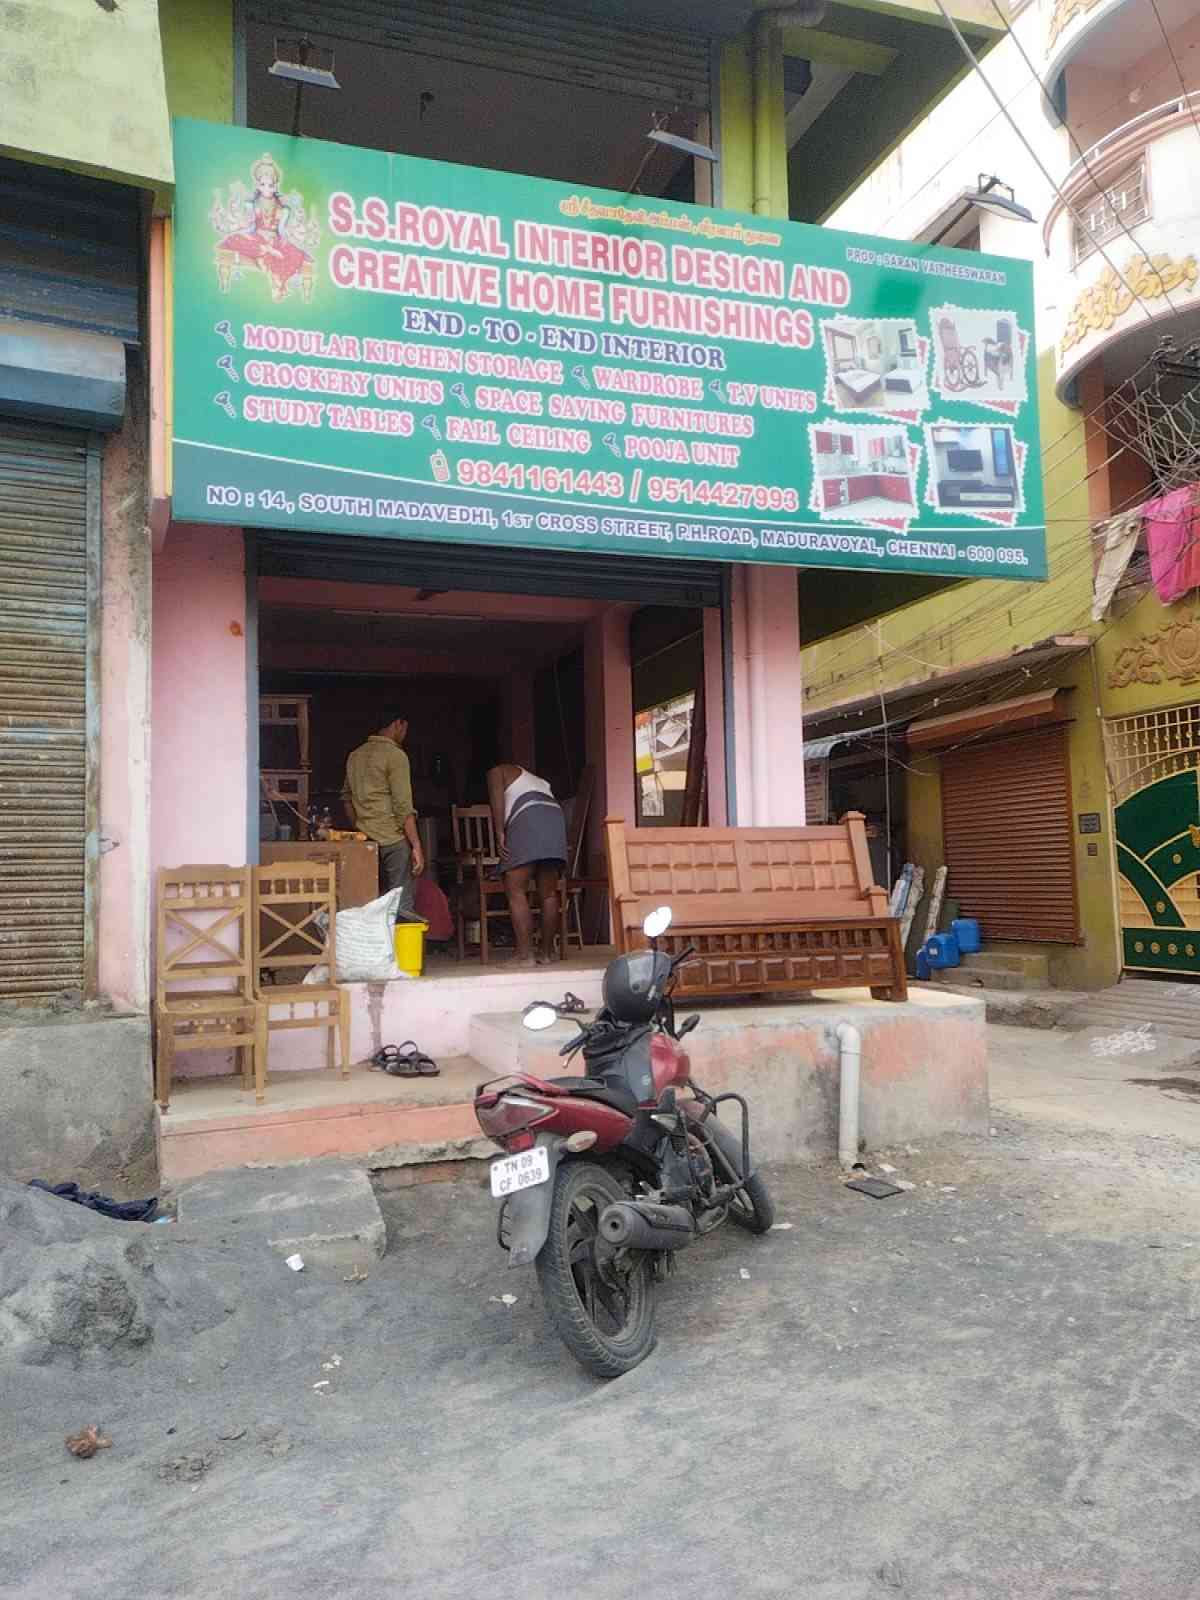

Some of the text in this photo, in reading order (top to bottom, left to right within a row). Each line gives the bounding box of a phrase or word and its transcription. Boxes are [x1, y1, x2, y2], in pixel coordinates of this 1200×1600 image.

[331, 193, 849, 306] S.S.ROYAL INTERIOR DESIGN AND
[847, 248, 875, 265] PROP
[331, 245, 813, 347] CREATIVE HOME FURNISHINGS
[244, 324, 817, 412] MODULAR KITCHEN STORAGE WARDROBE T.V UNITS
[404, 308, 463, 336] END
[484, 318, 521, 343] TO
[541, 327, 597, 353] END
[603, 334, 725, 369] INTERIOR
[244, 360, 754, 437] CROCKERY UNITS SPACE SAVING FURNITURES
[244, 396, 740, 468] STUDY TABLES FALL CEILING POOJA UNIT
[458, 459, 800, 513] 9841161443 / 9514427993
[207, 486, 241, 505] NO
[259, 490, 295, 514] 14,
[300, 494, 372, 517] SOUTH
[377, 501, 498, 528] MADAVEDHI,
[502, 511, 533, 529] 1ST
[537, 512, 599, 533] CROSS
[602, 519, 673, 542] STREET,
[676, 522, 759, 549] P.H.ROAD,
[762, 530, 885, 557] MADURAVOYAL,
[886, 539, 956, 560] CHENNAI
[967, 546, 994, 562] 600
[997, 549, 1029, 565] 095.
[500, 1167, 542, 1192] CF 0639
[504, 1155, 533, 1173] TN 09
